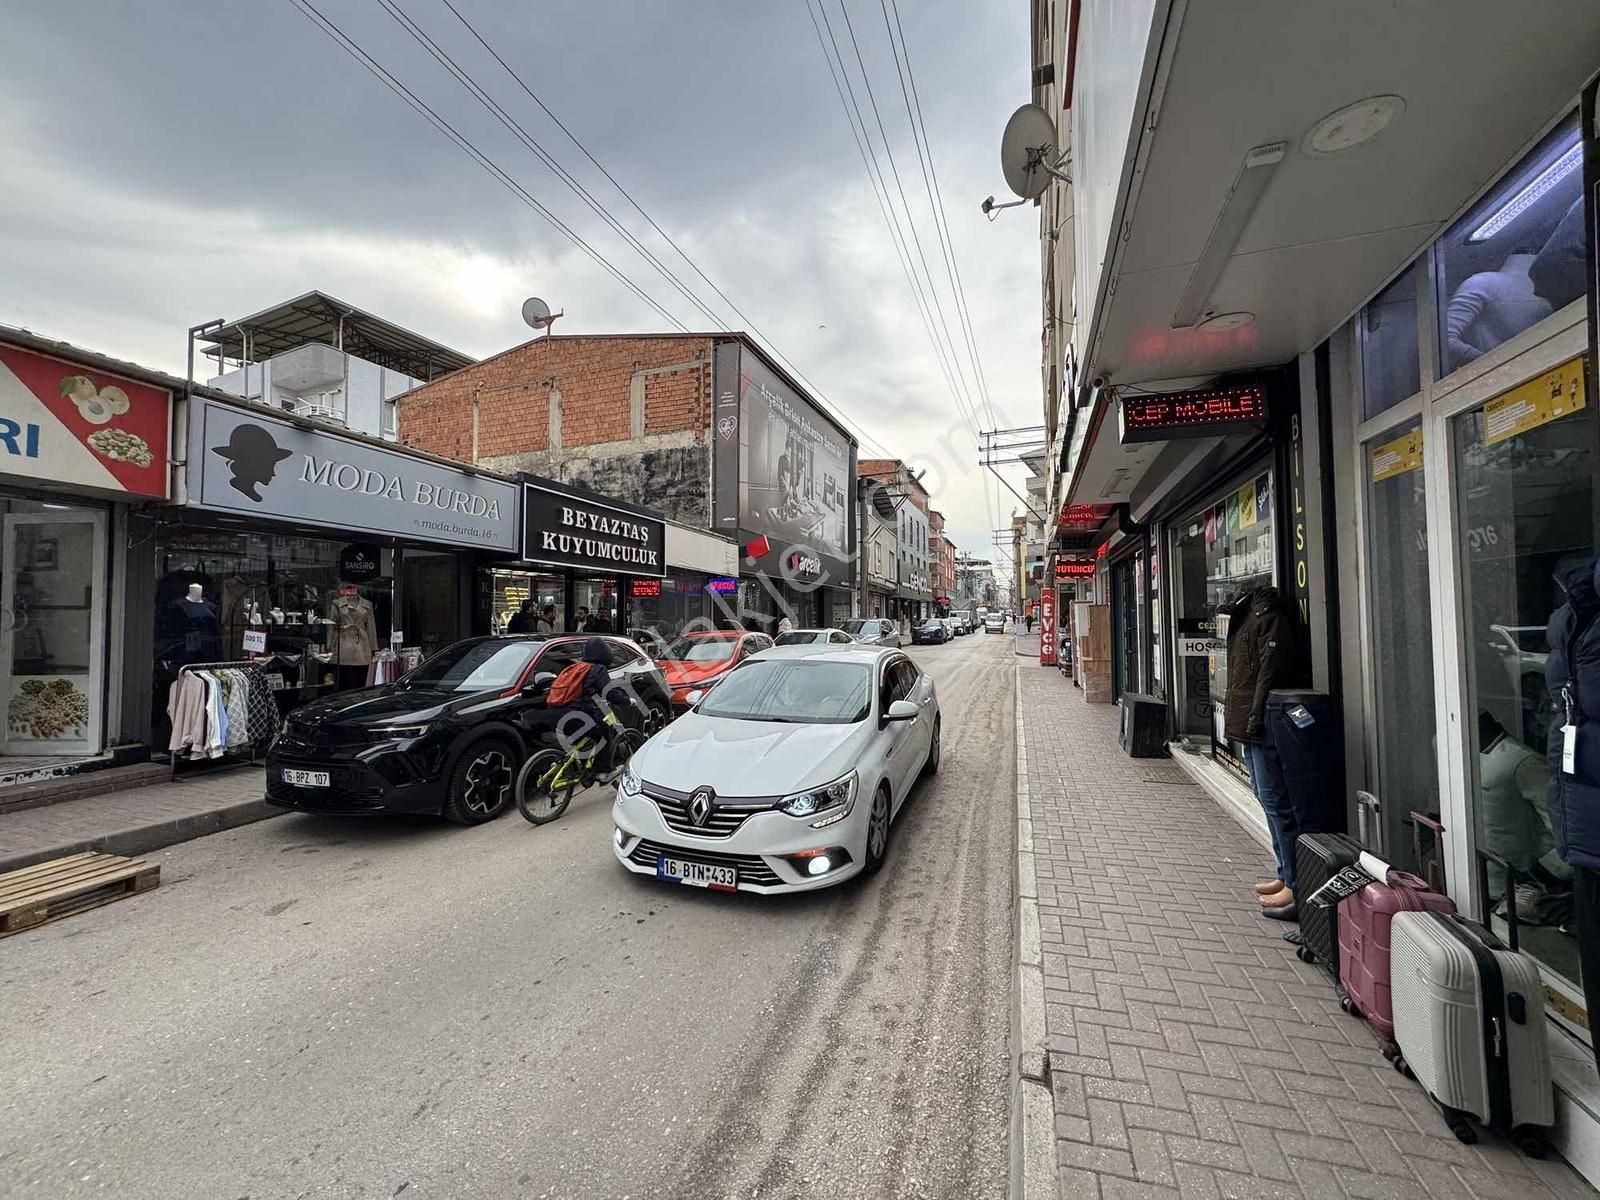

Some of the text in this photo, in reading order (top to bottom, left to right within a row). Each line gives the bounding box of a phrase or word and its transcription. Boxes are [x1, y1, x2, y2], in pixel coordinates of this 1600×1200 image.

[298, 454, 502, 521] MODA BURDA
[421, 519, 492, 539] moda.burda.16
[562, 506, 649, 546] BEYAZTAŞ
[542, 531, 657, 566] KUYUMCULUK
[799, 556, 821, 576] arçelik
[285, 770, 328, 785] 16 BPZ 107
[665, 860, 734, 884] 16 BTN 433
